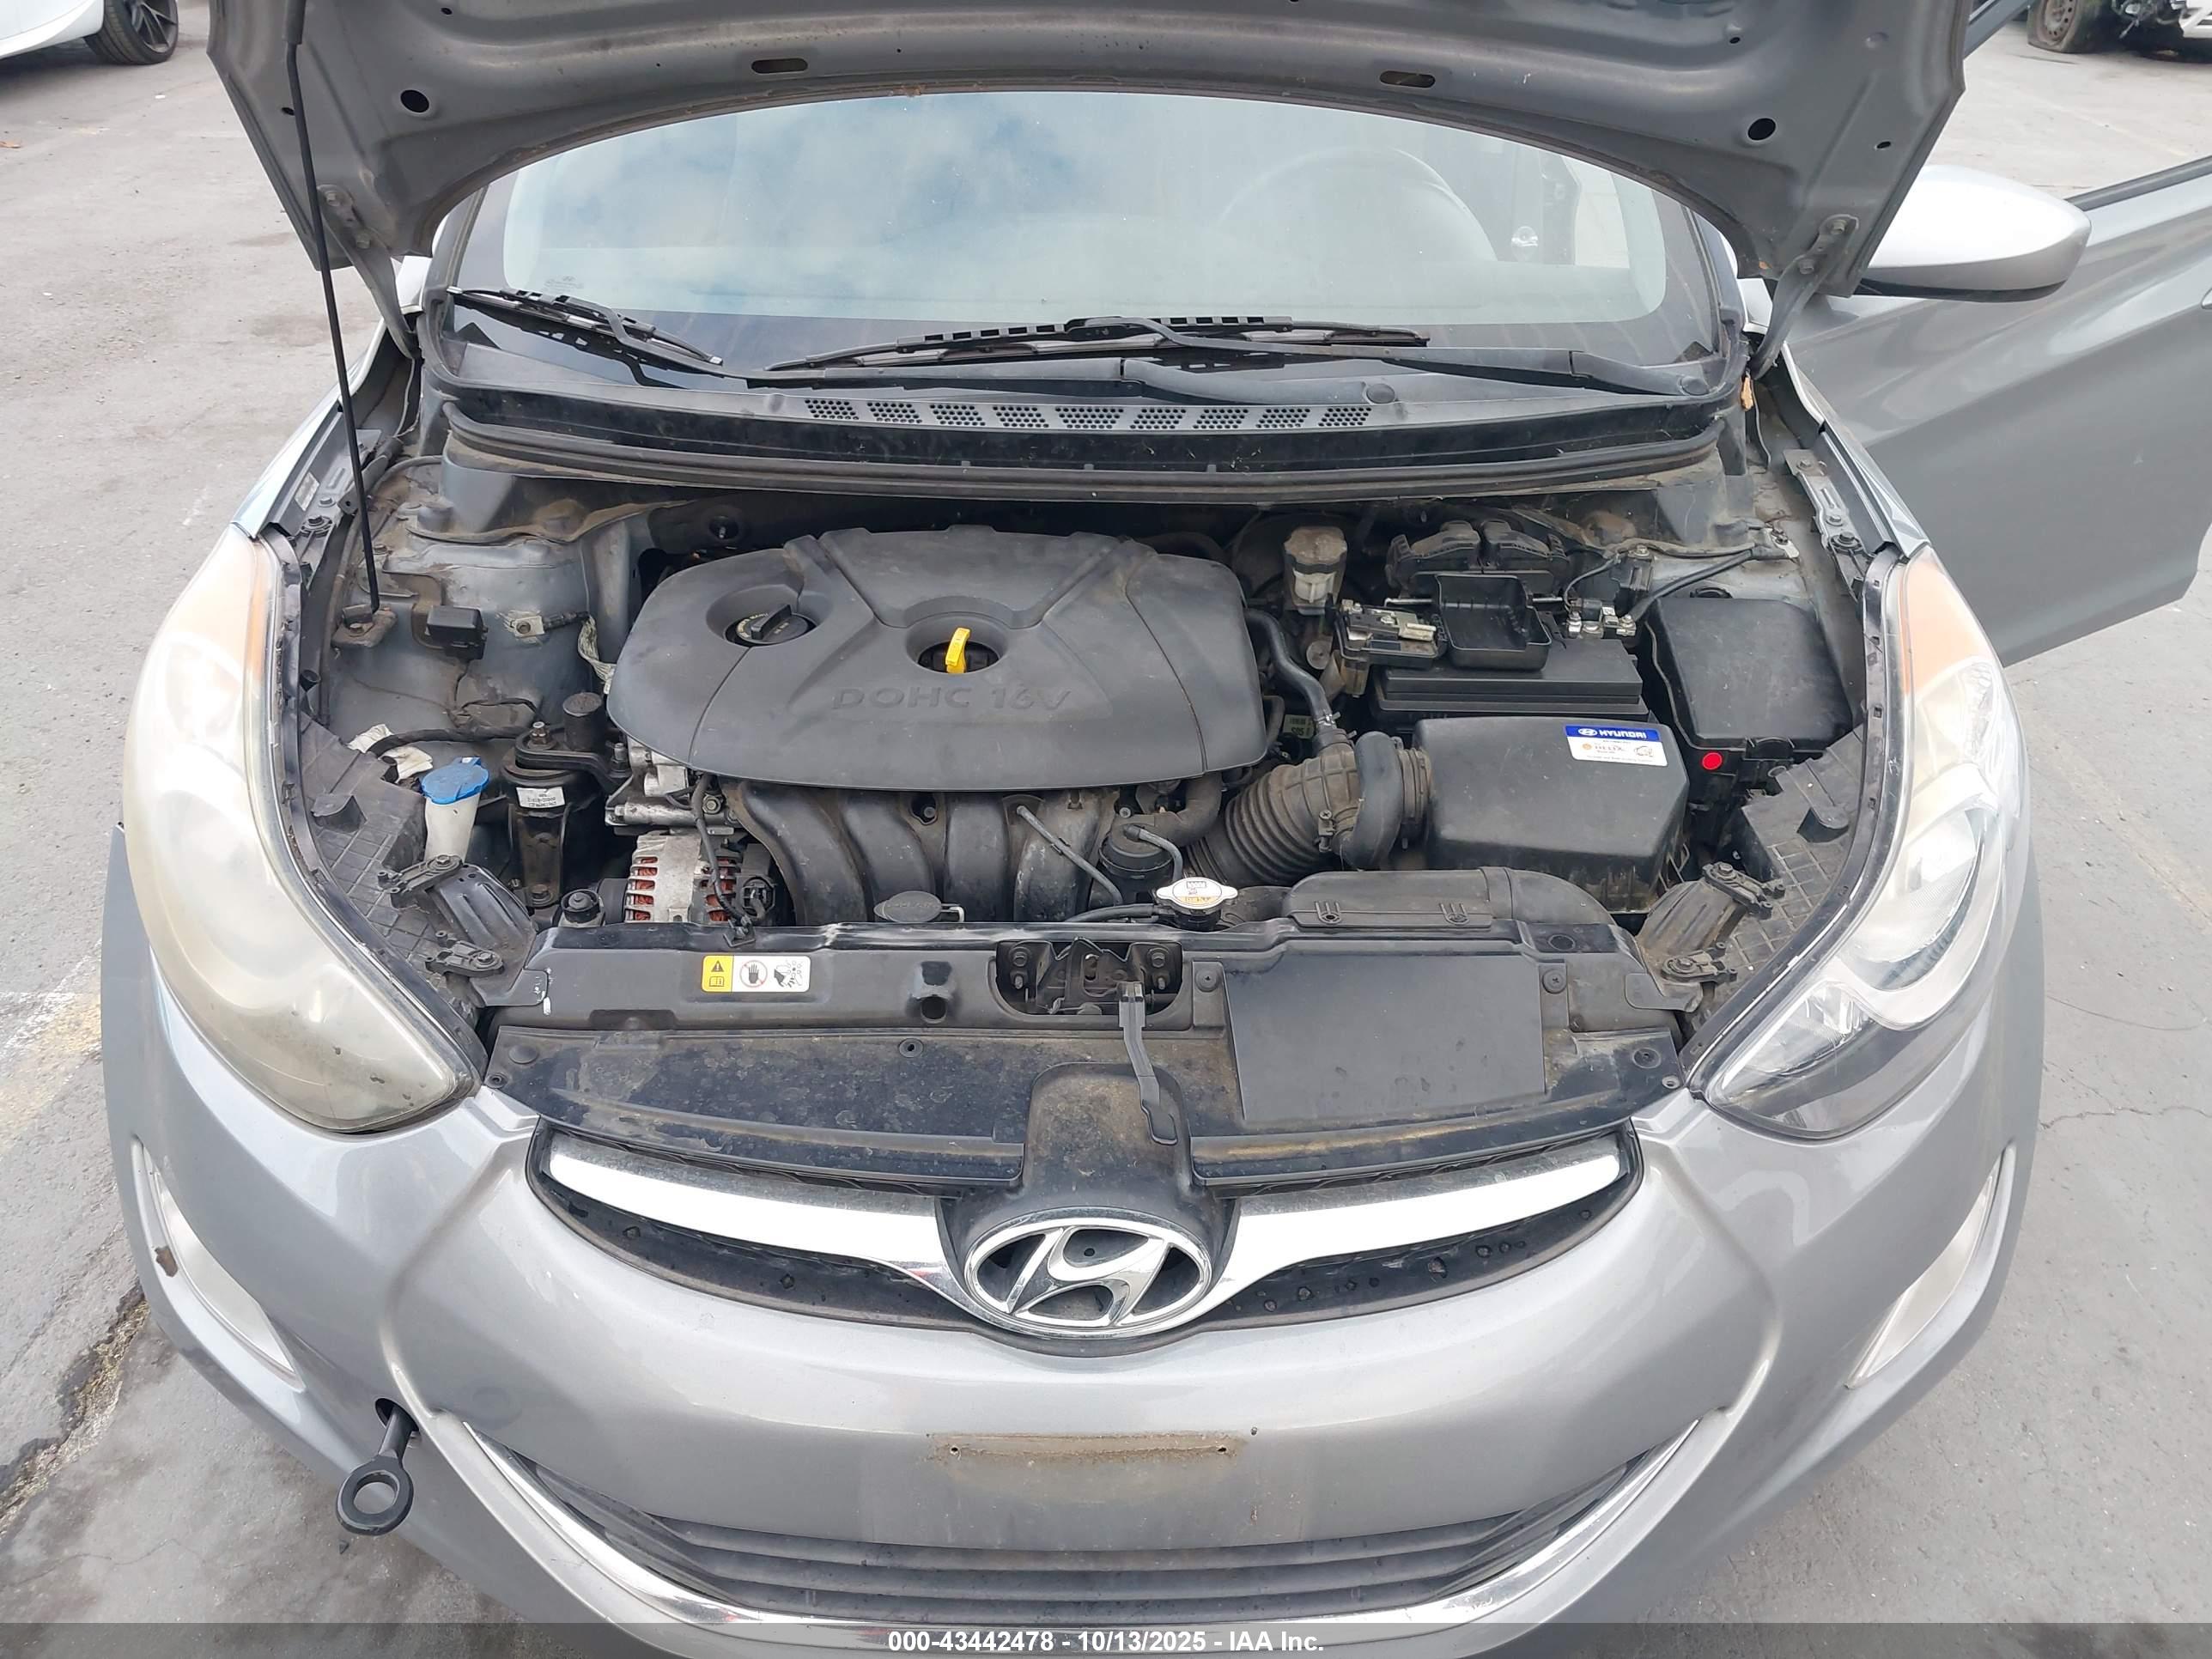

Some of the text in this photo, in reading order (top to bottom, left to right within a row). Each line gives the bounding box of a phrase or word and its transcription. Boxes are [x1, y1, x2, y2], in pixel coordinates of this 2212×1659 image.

[831, 686, 1073, 711] DOHC 16V
[1599, 729, 1648, 739] HYUNDAI
